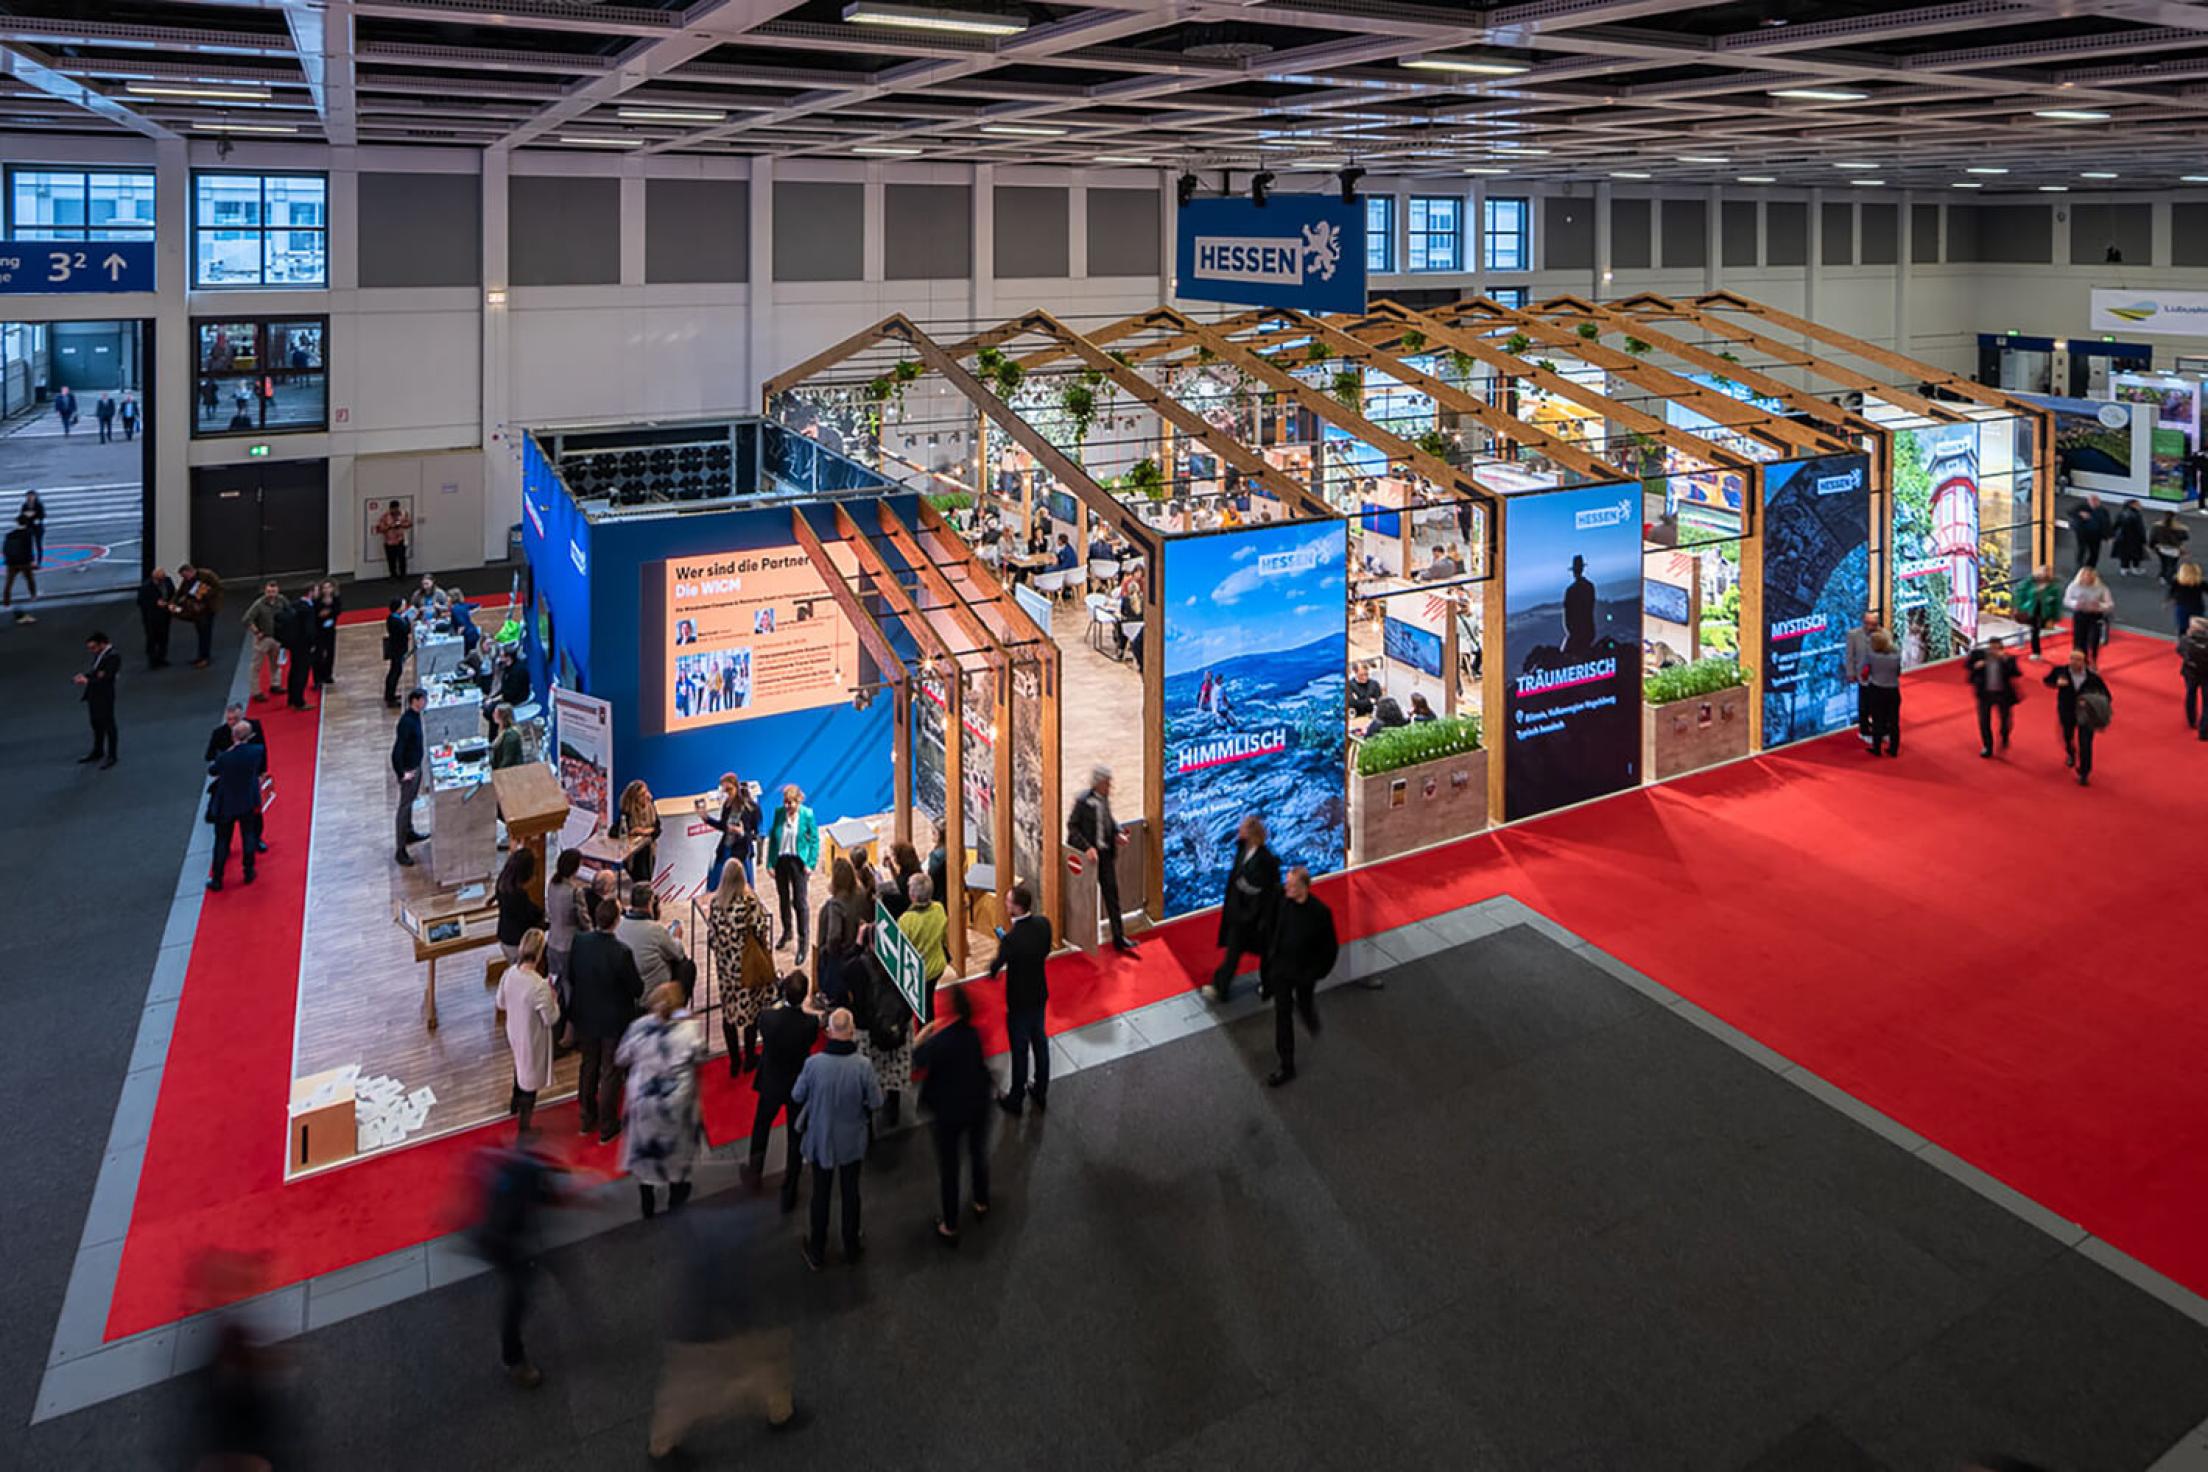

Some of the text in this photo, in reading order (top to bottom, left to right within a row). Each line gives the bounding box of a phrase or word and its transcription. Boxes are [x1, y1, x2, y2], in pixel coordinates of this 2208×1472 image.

[1200, 244, 1296, 275] HESSEN
[676, 555, 809, 580] Wer sind die Partner
[675, 583, 699, 598] Die
[1771, 613, 1827, 638] MYSTISCH
[1516, 658, 1616, 693] TRÄUMERISCH
[1180, 728, 1286, 768] HIMMLISCH
